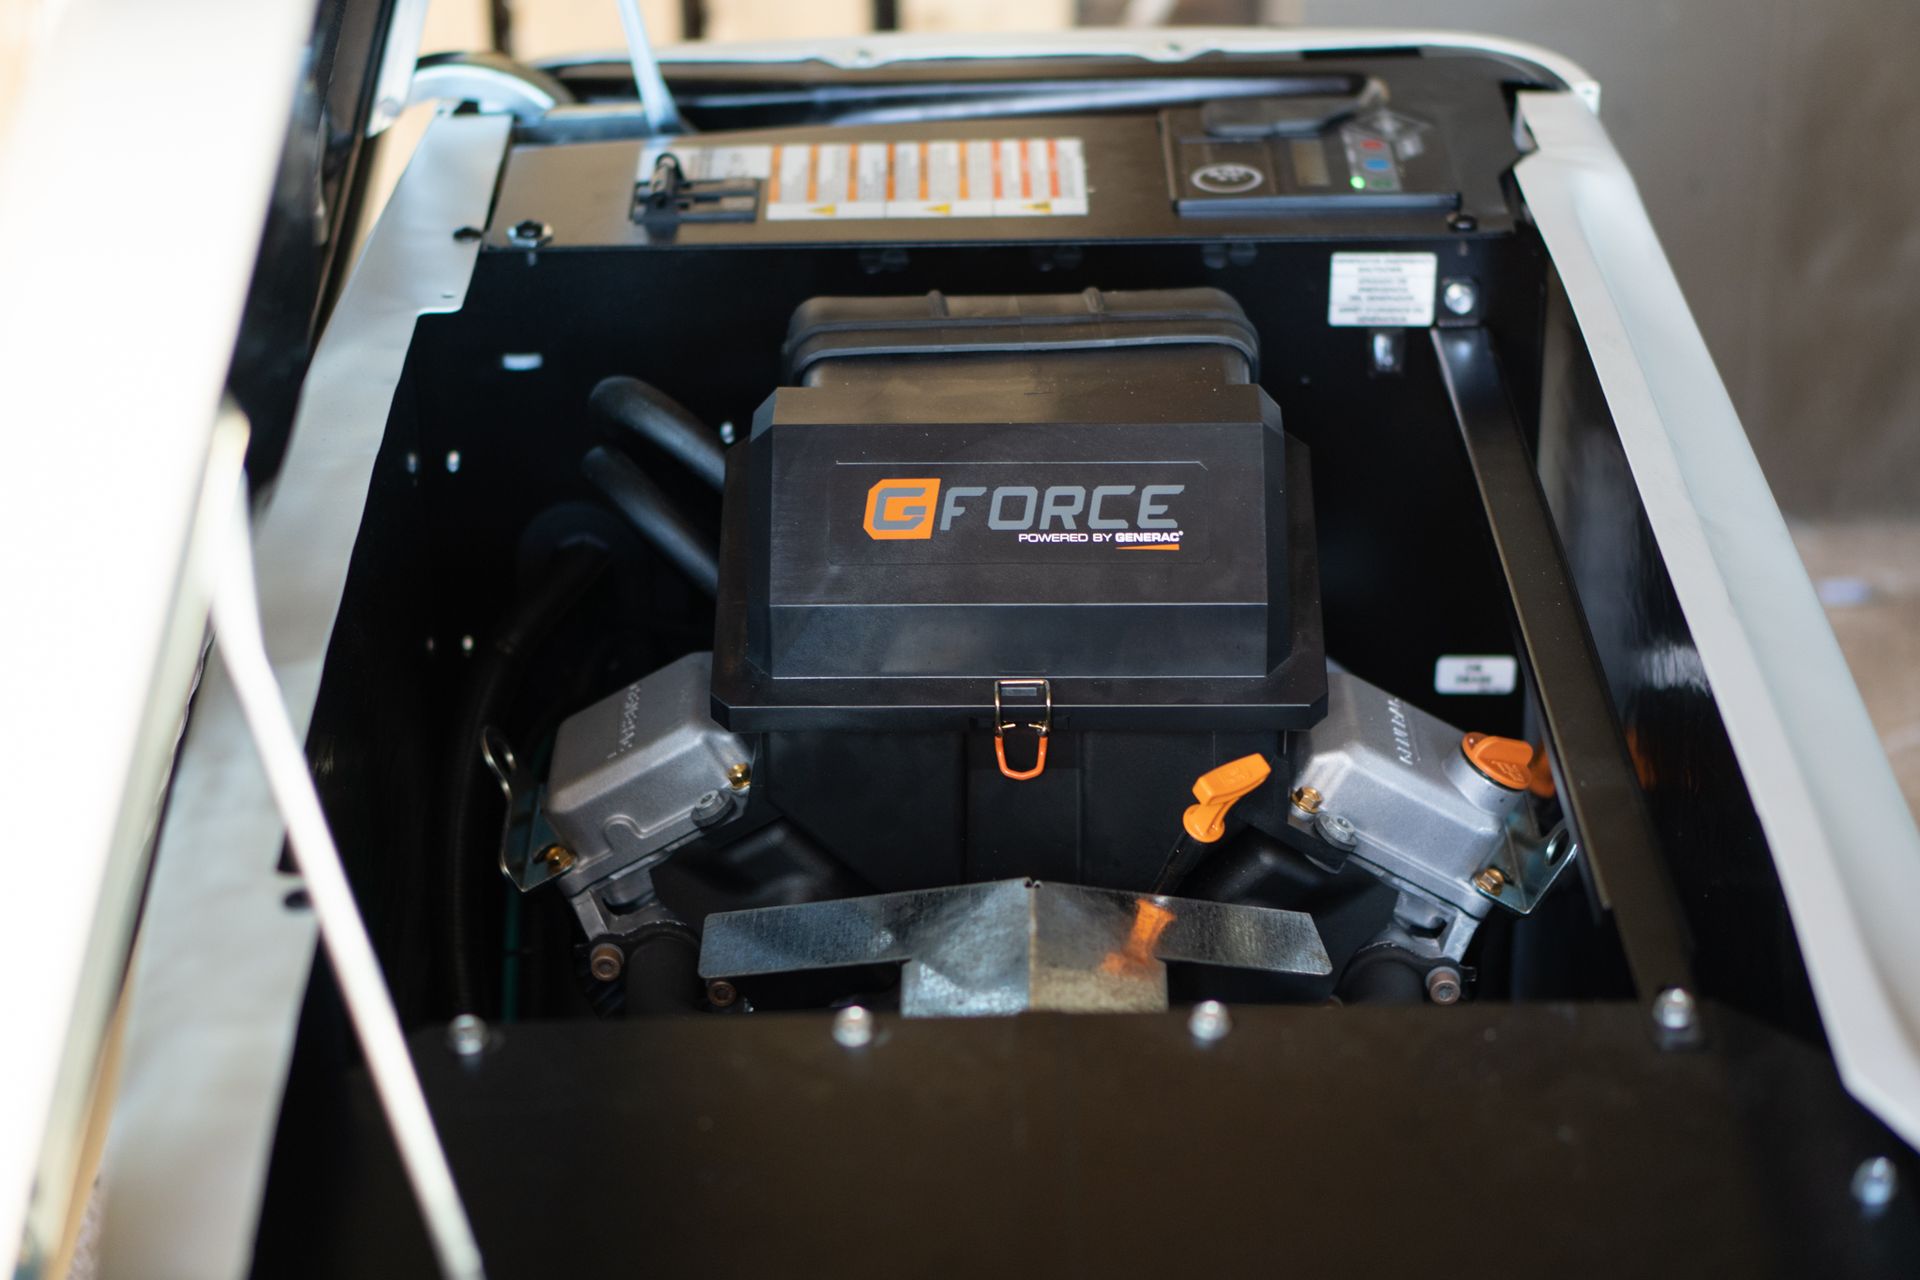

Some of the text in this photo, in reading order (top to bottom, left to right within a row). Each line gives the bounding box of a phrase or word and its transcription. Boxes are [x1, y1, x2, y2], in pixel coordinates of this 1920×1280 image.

[870, 484, 1185, 532] G FORCE
[1018, 532, 1089, 543] POWERED
[1092, 532, 1112, 543] BY
